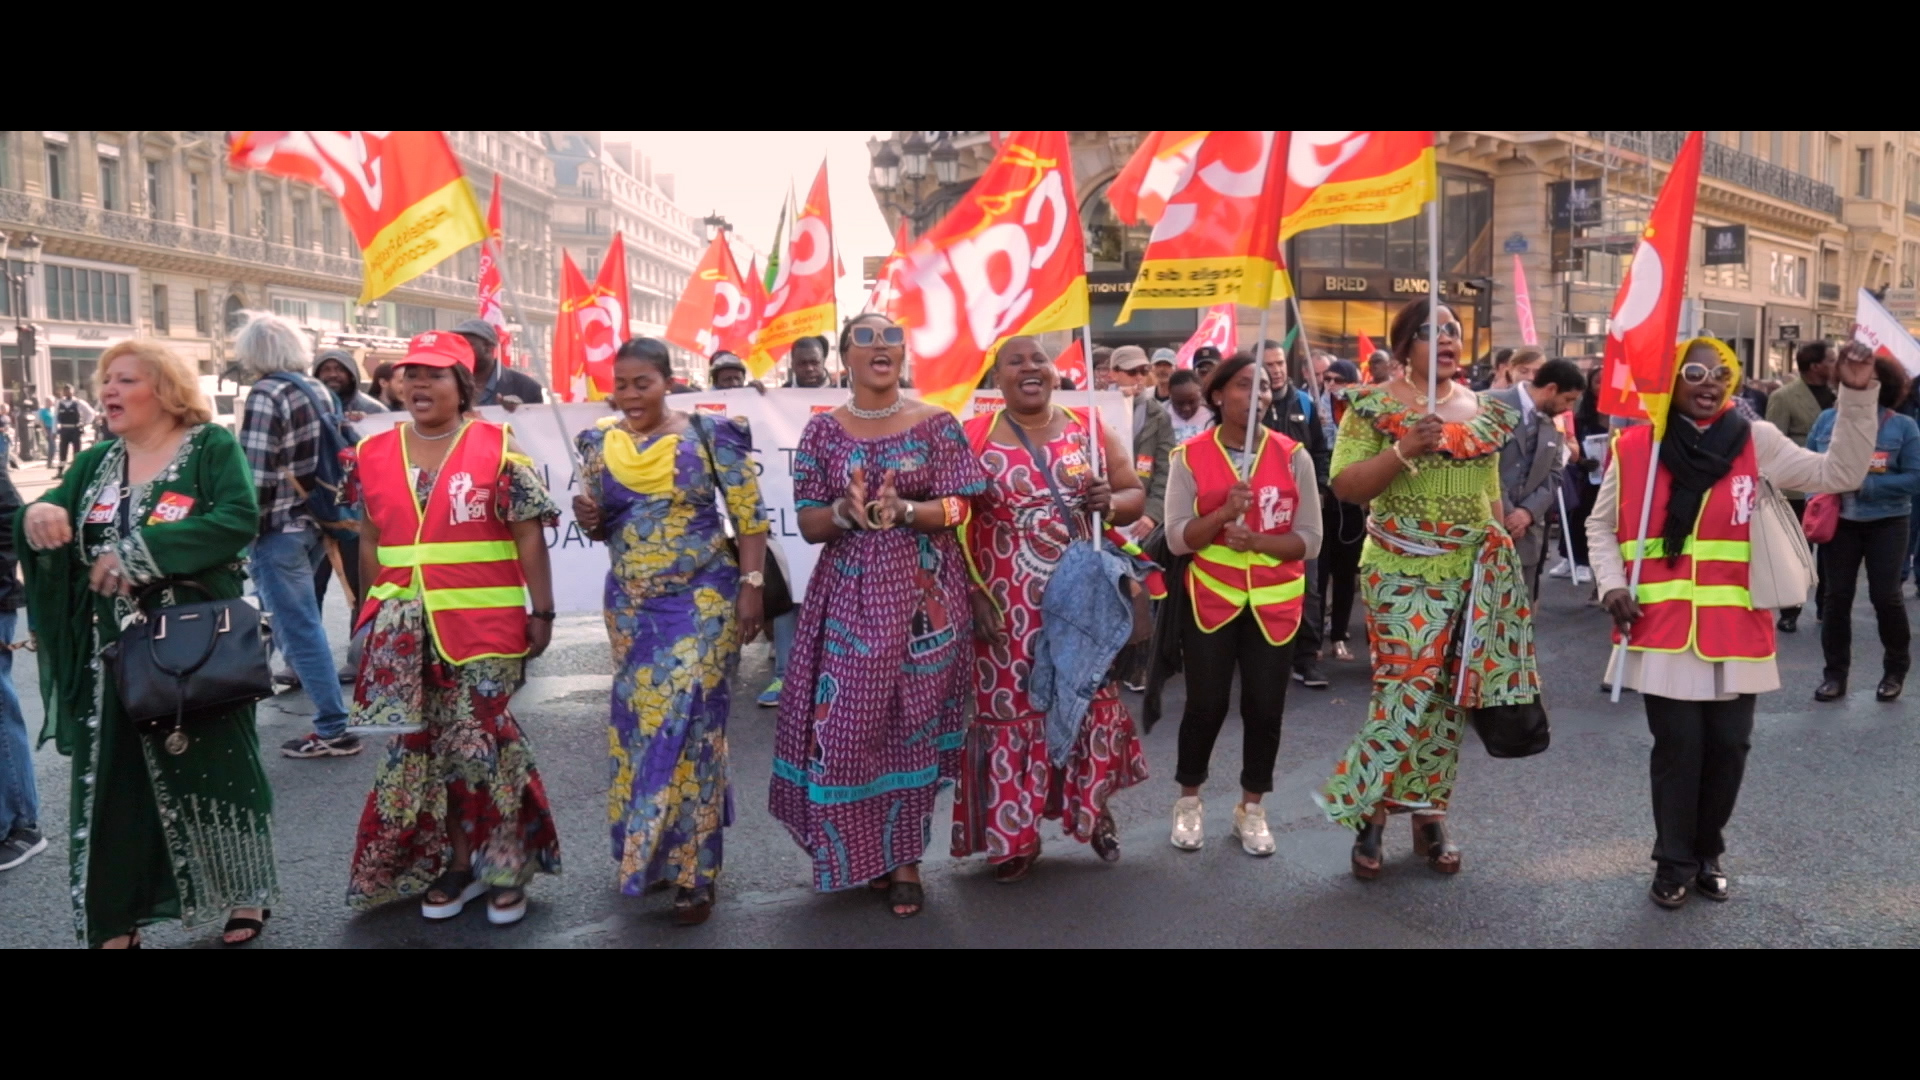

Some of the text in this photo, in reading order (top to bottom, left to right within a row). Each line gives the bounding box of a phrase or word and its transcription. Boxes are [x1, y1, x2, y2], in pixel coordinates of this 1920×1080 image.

[1325, 276, 1368, 292] BRED
[1393, 277, 1447, 295] BANQE
[88, 509, 112, 522] cgt
[155, 502, 189, 521] cgt
[466, 502, 486, 518] cgt
